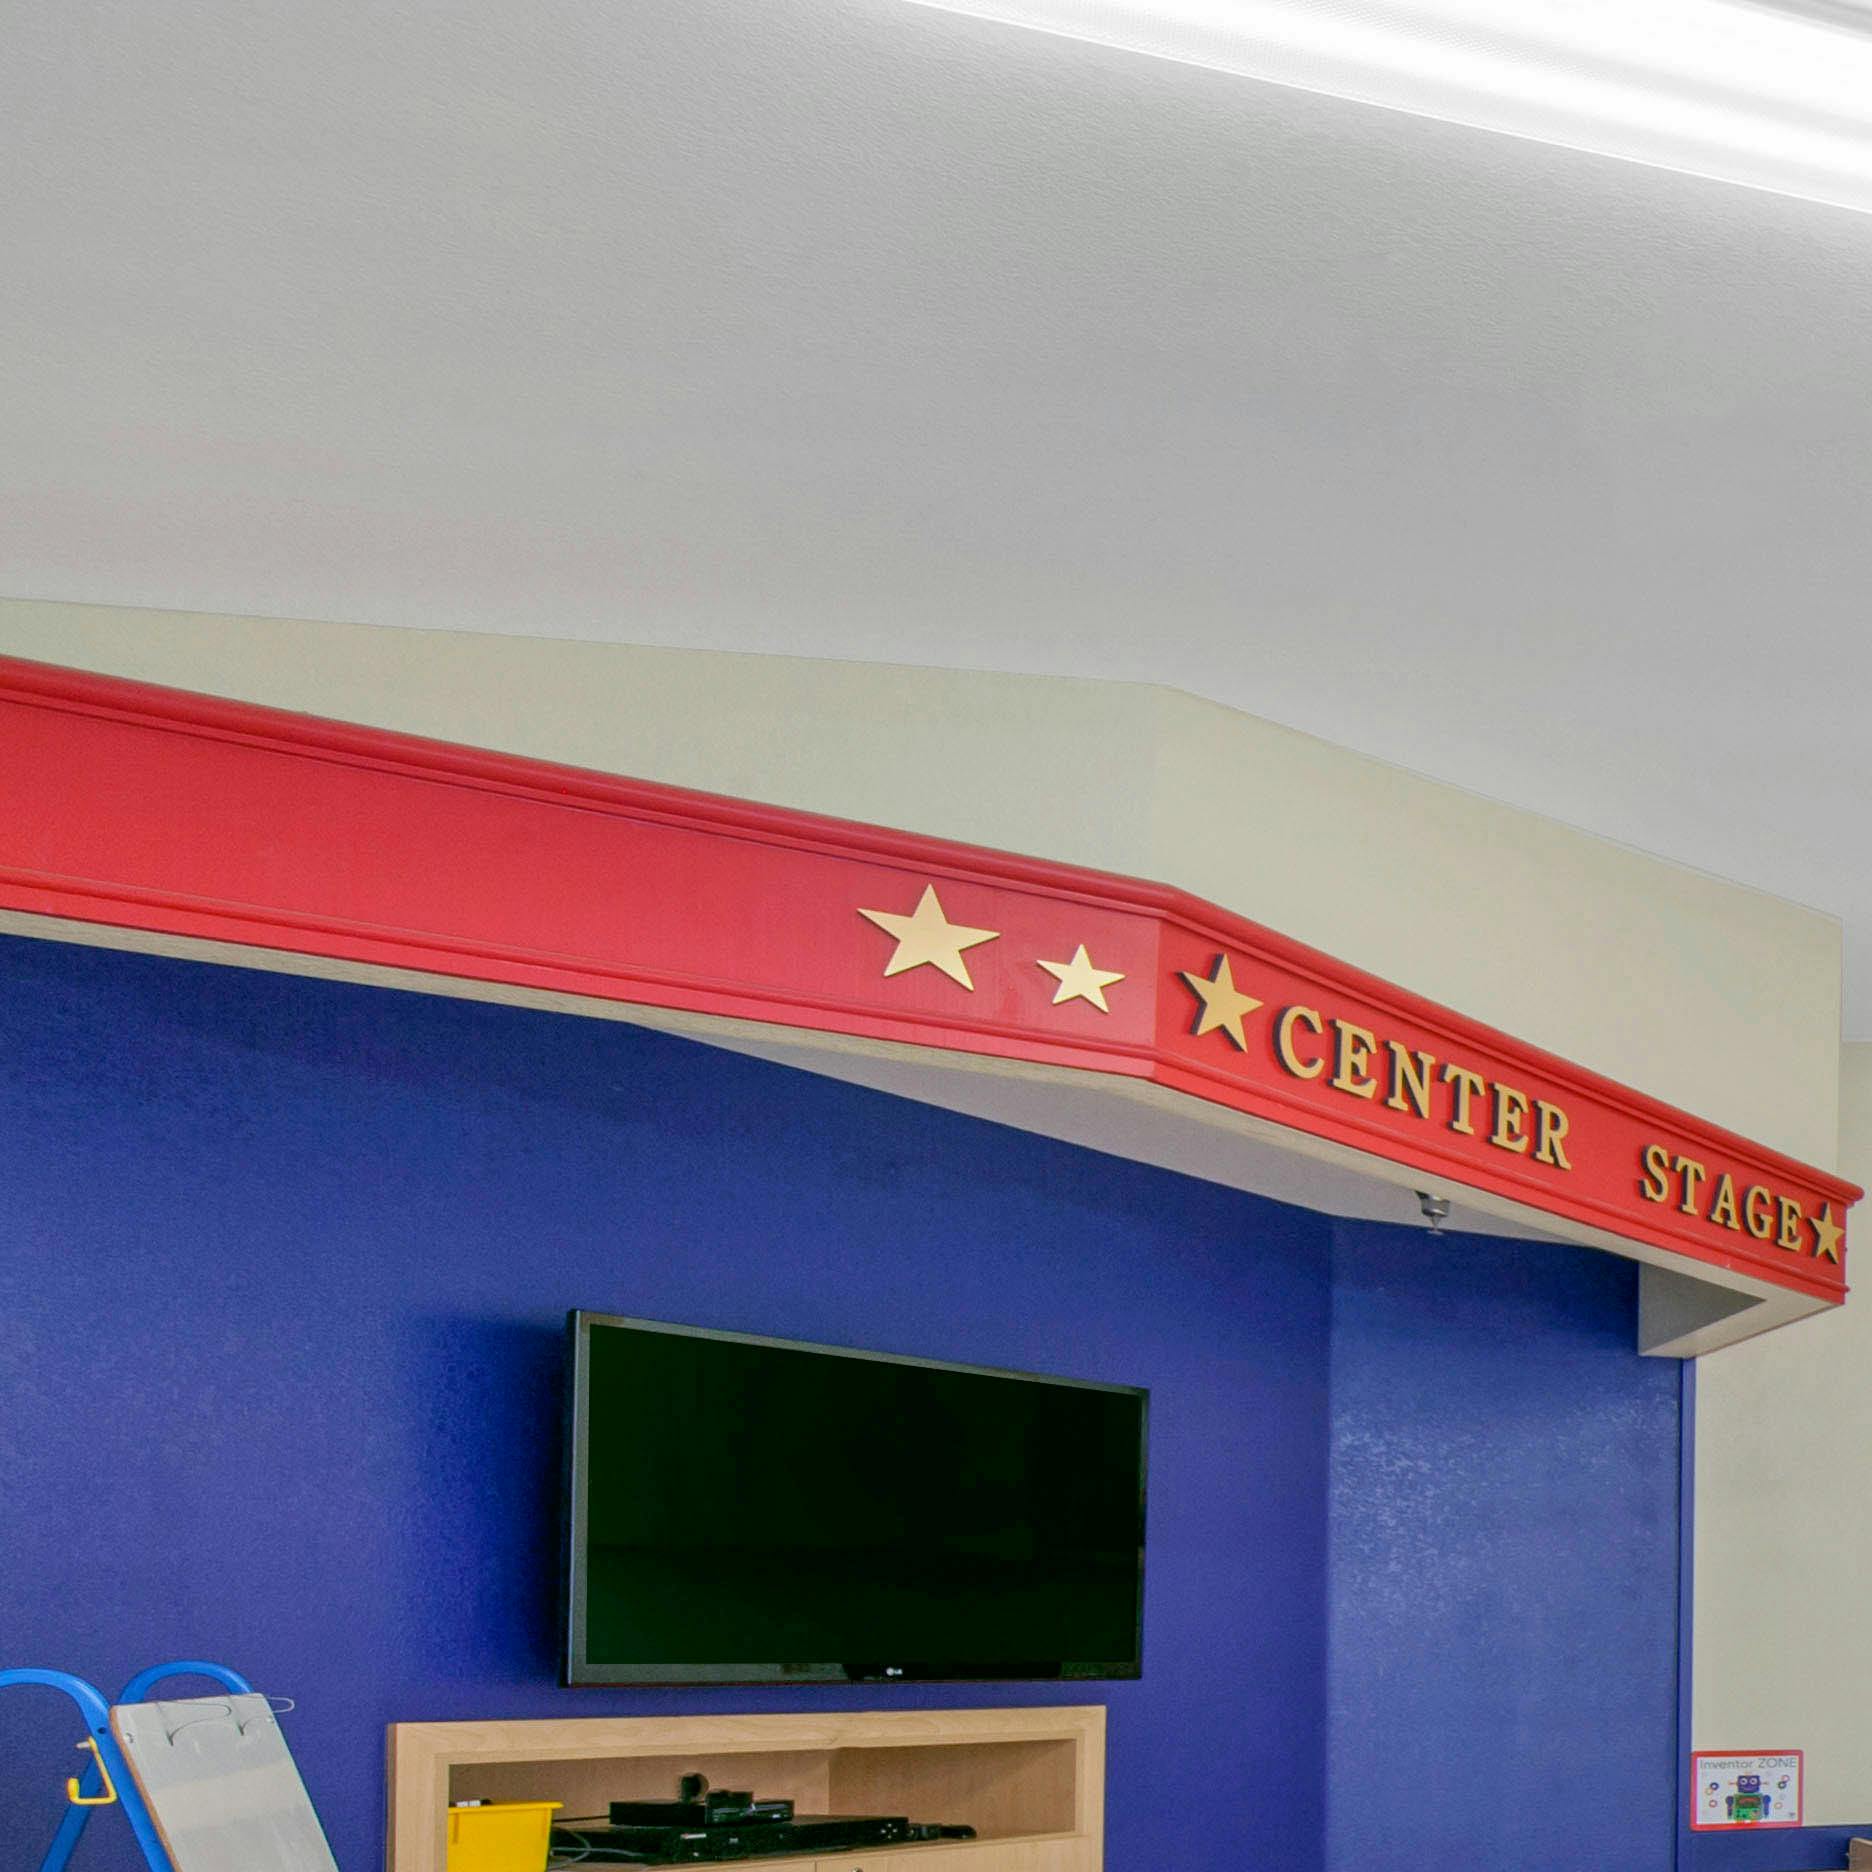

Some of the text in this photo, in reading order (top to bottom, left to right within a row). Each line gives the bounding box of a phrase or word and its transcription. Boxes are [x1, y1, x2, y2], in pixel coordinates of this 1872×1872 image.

[1277, 1006, 1803, 1250] CENTER STAGE
[1700, 1757, 1797, 1769] Inventor ZONE
